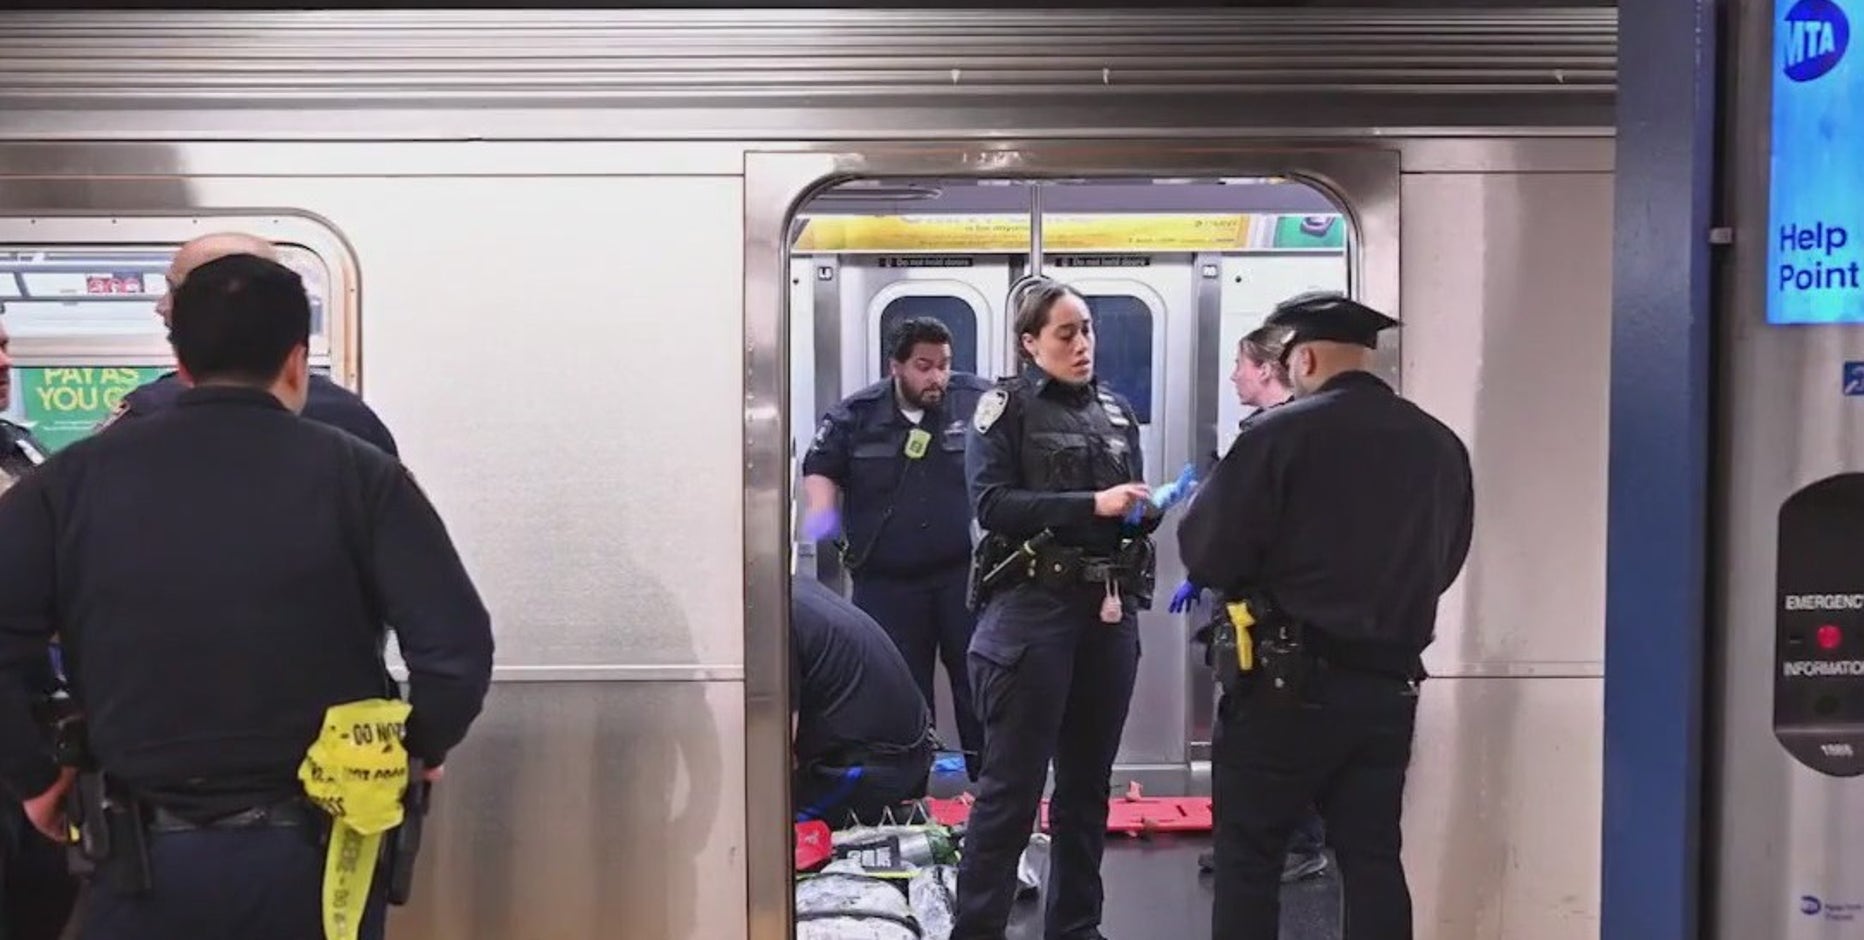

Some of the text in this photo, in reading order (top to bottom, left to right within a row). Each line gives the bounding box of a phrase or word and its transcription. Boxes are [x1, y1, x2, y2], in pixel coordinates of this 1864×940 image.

[1782, 20, 1836, 66] MTA
[1780, 220, 1848, 256] Help
[1779, 260, 1860, 292] Point
[43, 368, 139, 386] PAY AS
[36, 386, 99, 412] YOU
